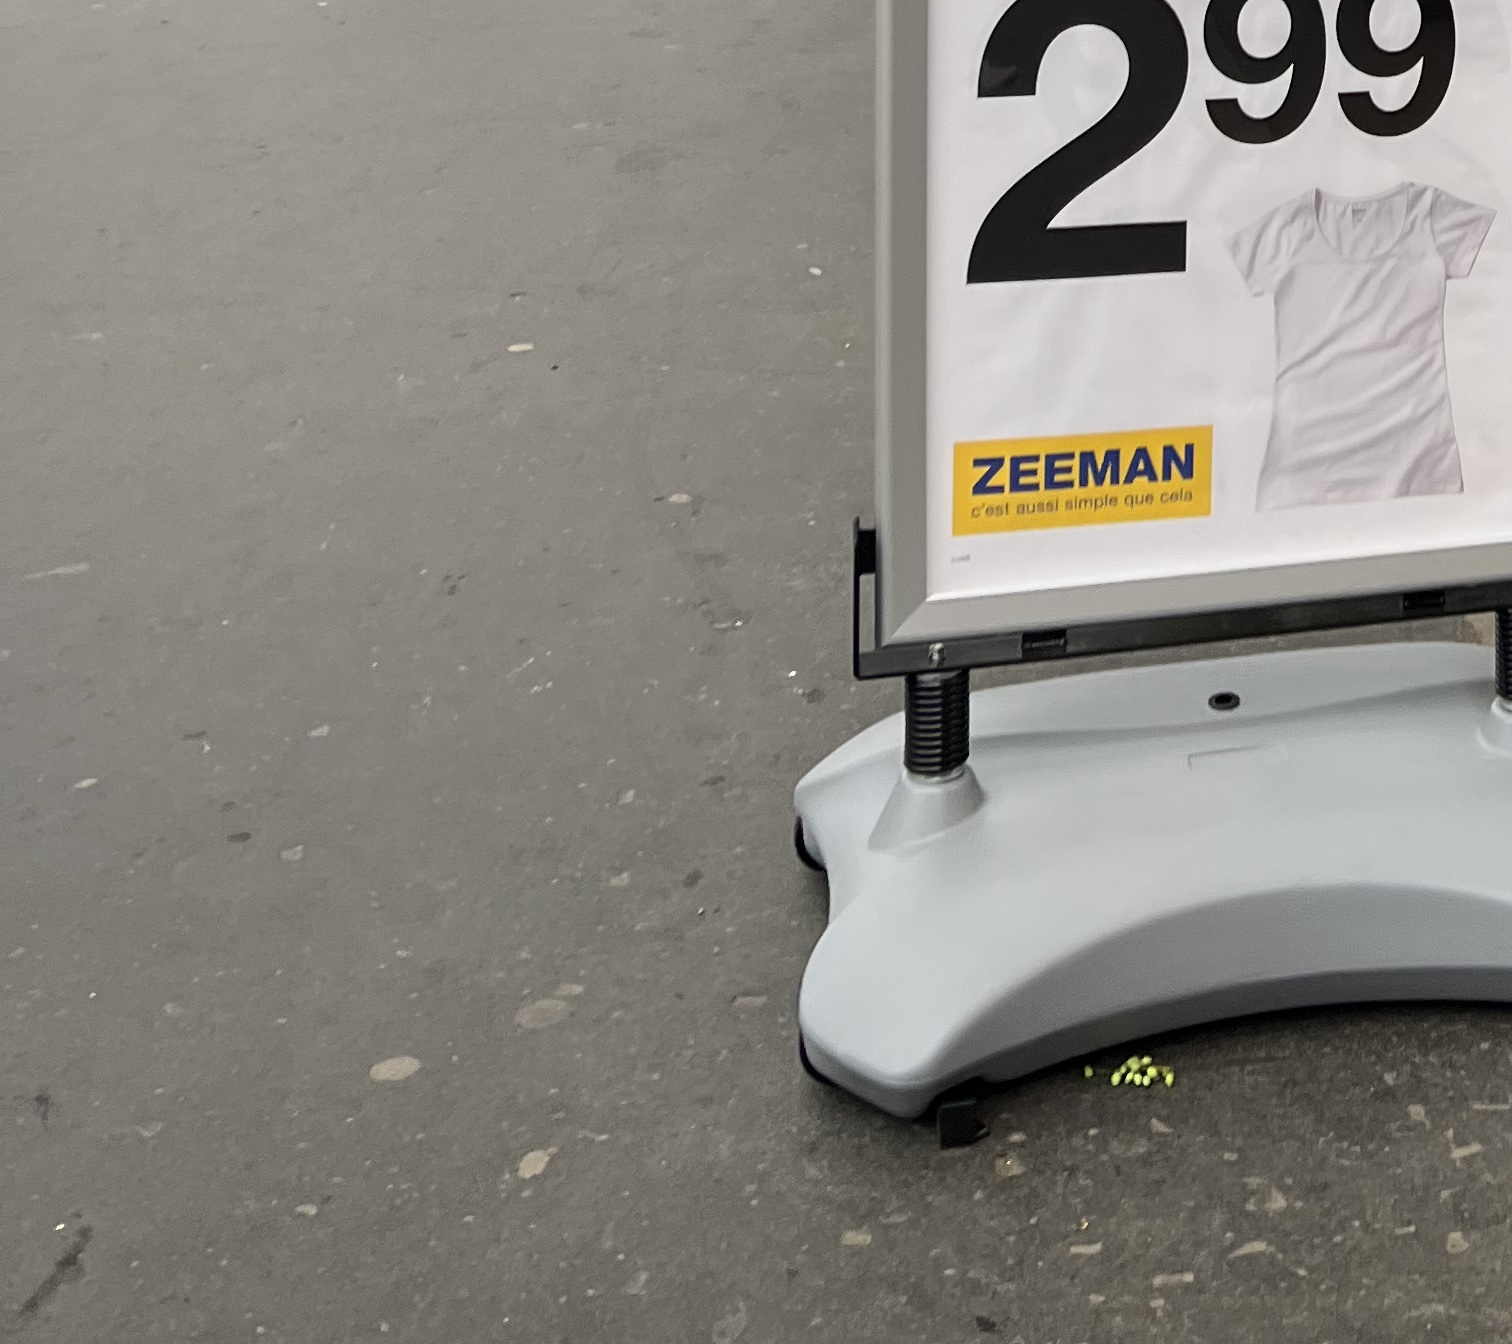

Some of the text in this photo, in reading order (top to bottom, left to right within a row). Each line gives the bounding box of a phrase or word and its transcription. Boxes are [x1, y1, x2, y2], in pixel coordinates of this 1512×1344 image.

[971, 443, 1195, 496] ZEEMAN
[971, 487, 1193, 519] c'est aussi simple que cela
